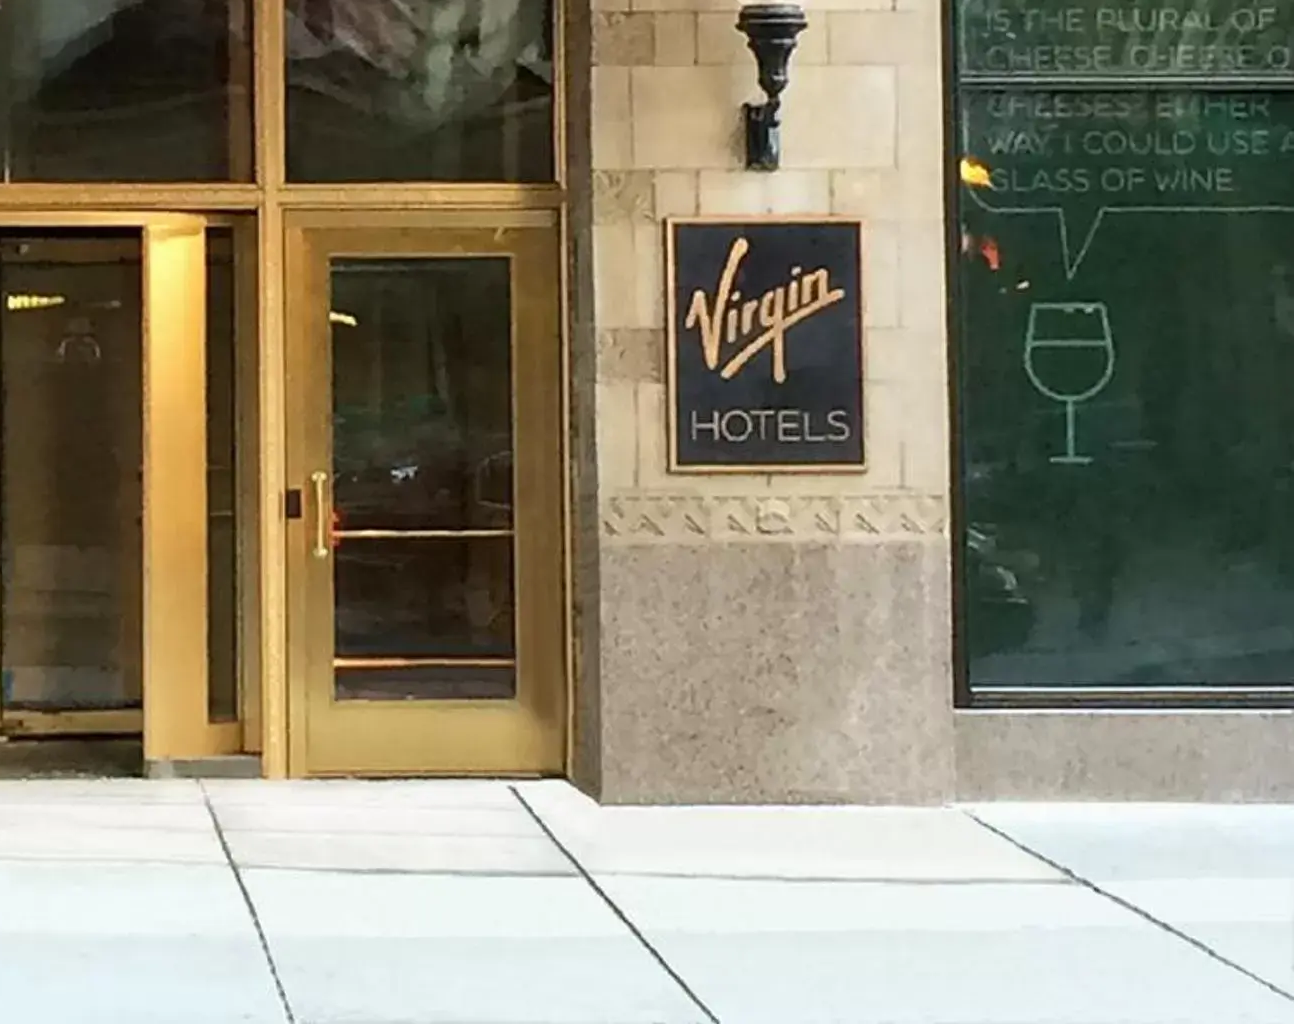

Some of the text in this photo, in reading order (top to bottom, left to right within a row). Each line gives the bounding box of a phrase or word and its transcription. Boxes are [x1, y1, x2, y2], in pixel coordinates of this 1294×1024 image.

[986, 8, 1277, 33] IS THE PLURAL OF
[1082, 130, 1196, 156] COULD
[1208, 129, 1270, 156] USE
[989, 167, 1235, 193] GLASS OF WINE
[684, 237, 846, 384] Virgin
[691, 410, 851, 443] HOTELS
